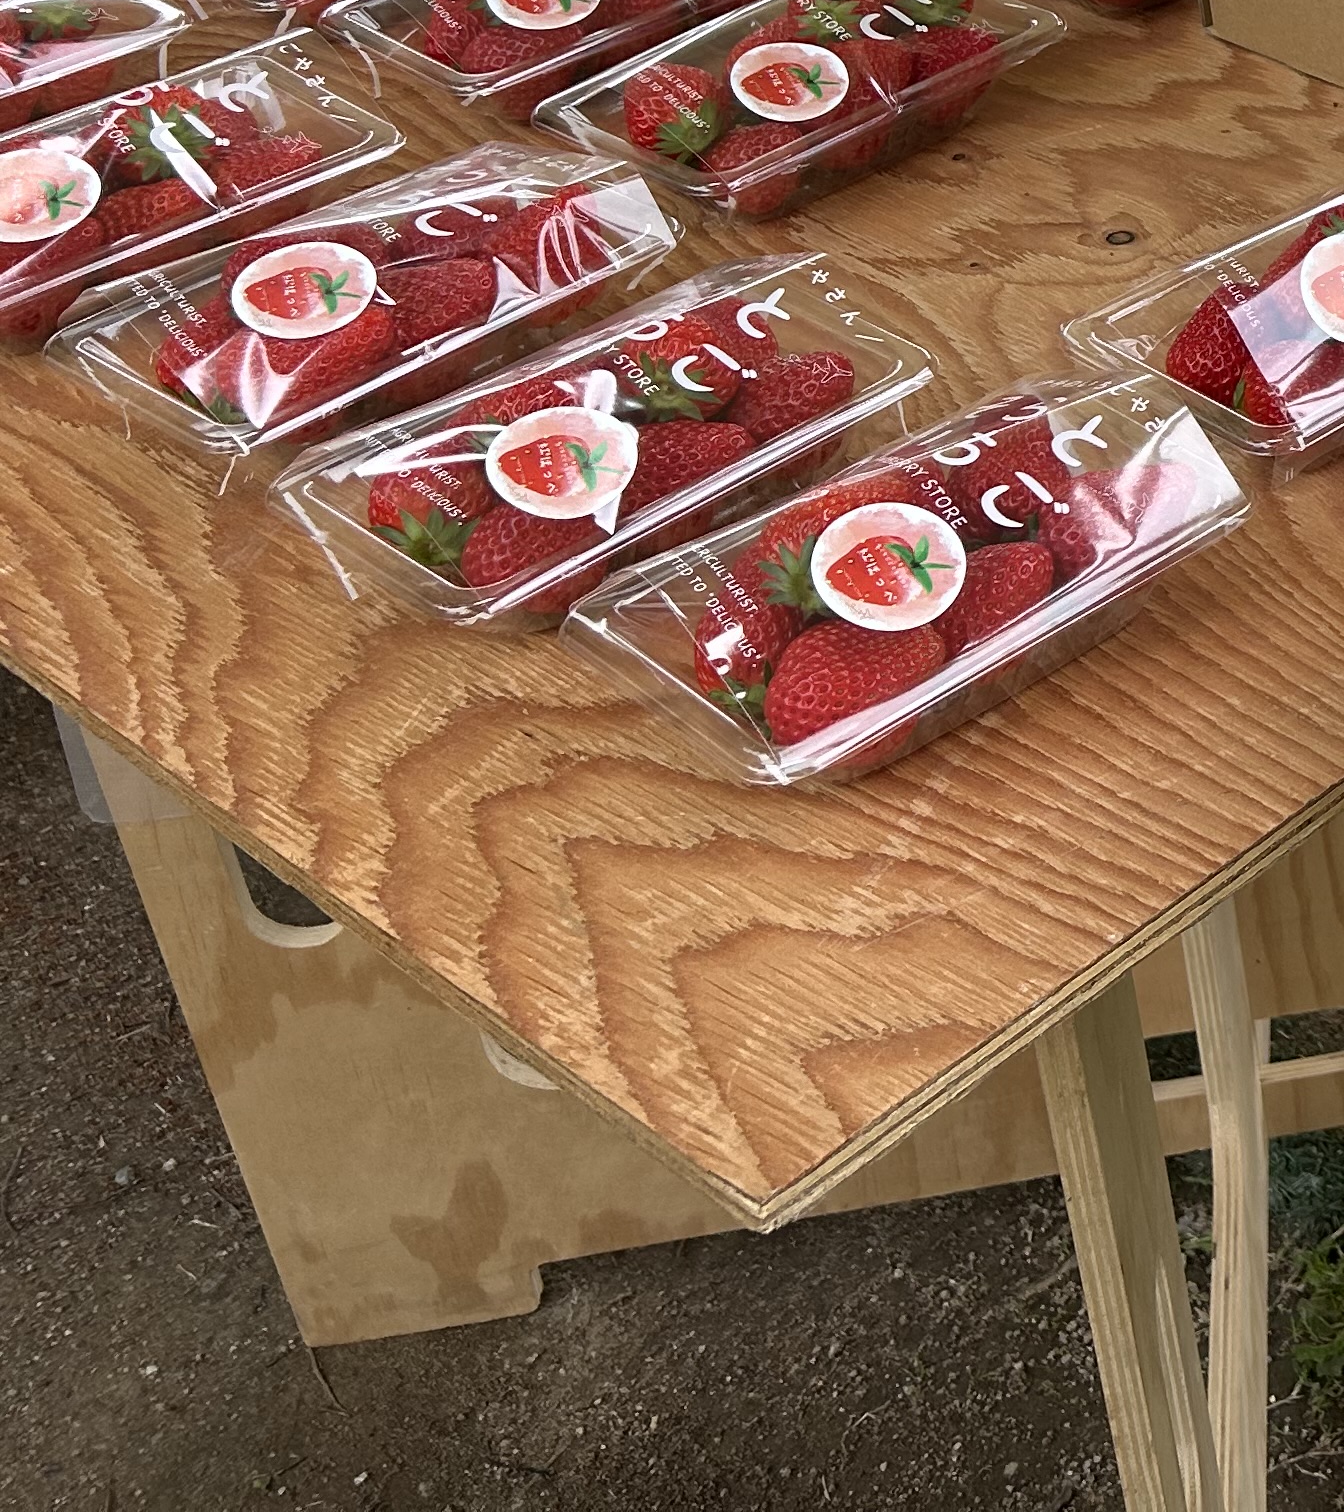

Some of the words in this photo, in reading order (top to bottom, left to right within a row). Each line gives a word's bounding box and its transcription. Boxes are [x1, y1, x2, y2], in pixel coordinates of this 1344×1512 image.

[813, 10, 853, 42] STORE
[612, 353, 661, 397] STORE
[919, 478, 969, 531] STORE
[689, 575, 708, 593] TO
